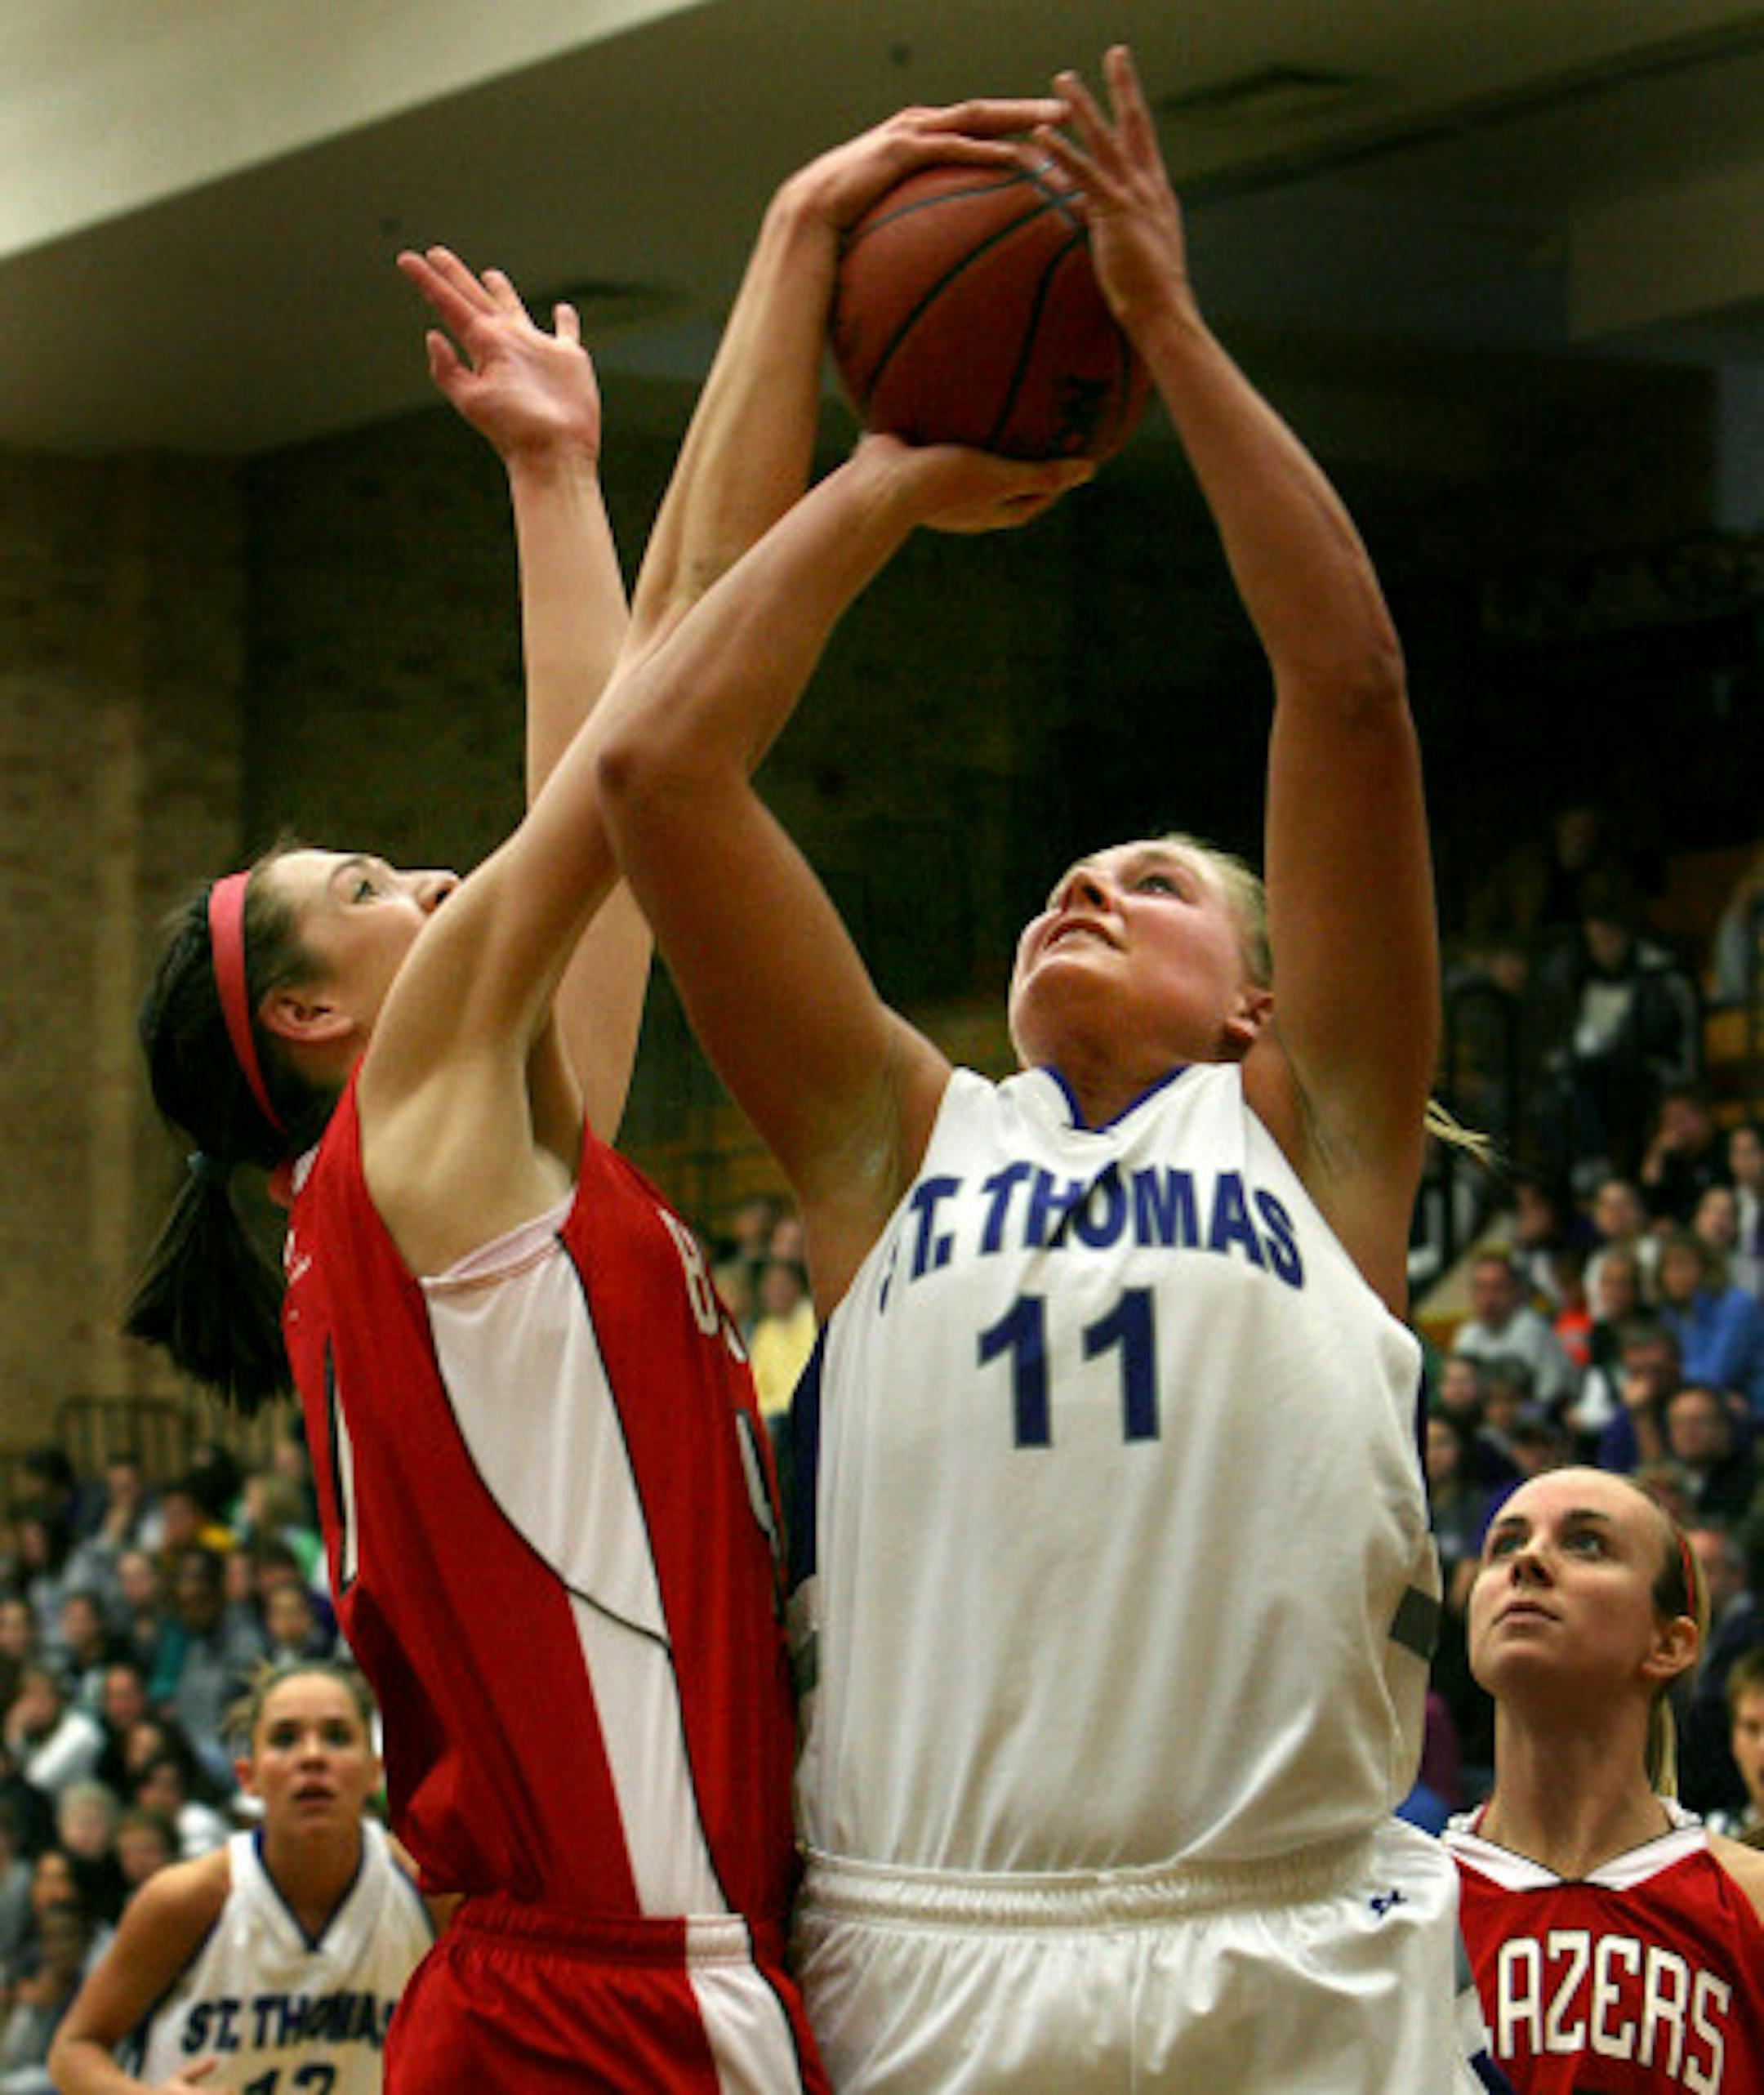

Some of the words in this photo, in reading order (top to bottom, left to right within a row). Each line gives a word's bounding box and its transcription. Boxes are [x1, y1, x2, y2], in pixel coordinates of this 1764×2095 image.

[880, 1176, 963, 1310] T.
[980, 1160, 1305, 1290] THOMAS
[976, 1285, 1160, 1450] 11
[251, 1988, 397, 2050] THOMA
[1482, 1929, 1732, 2095] AZERS
